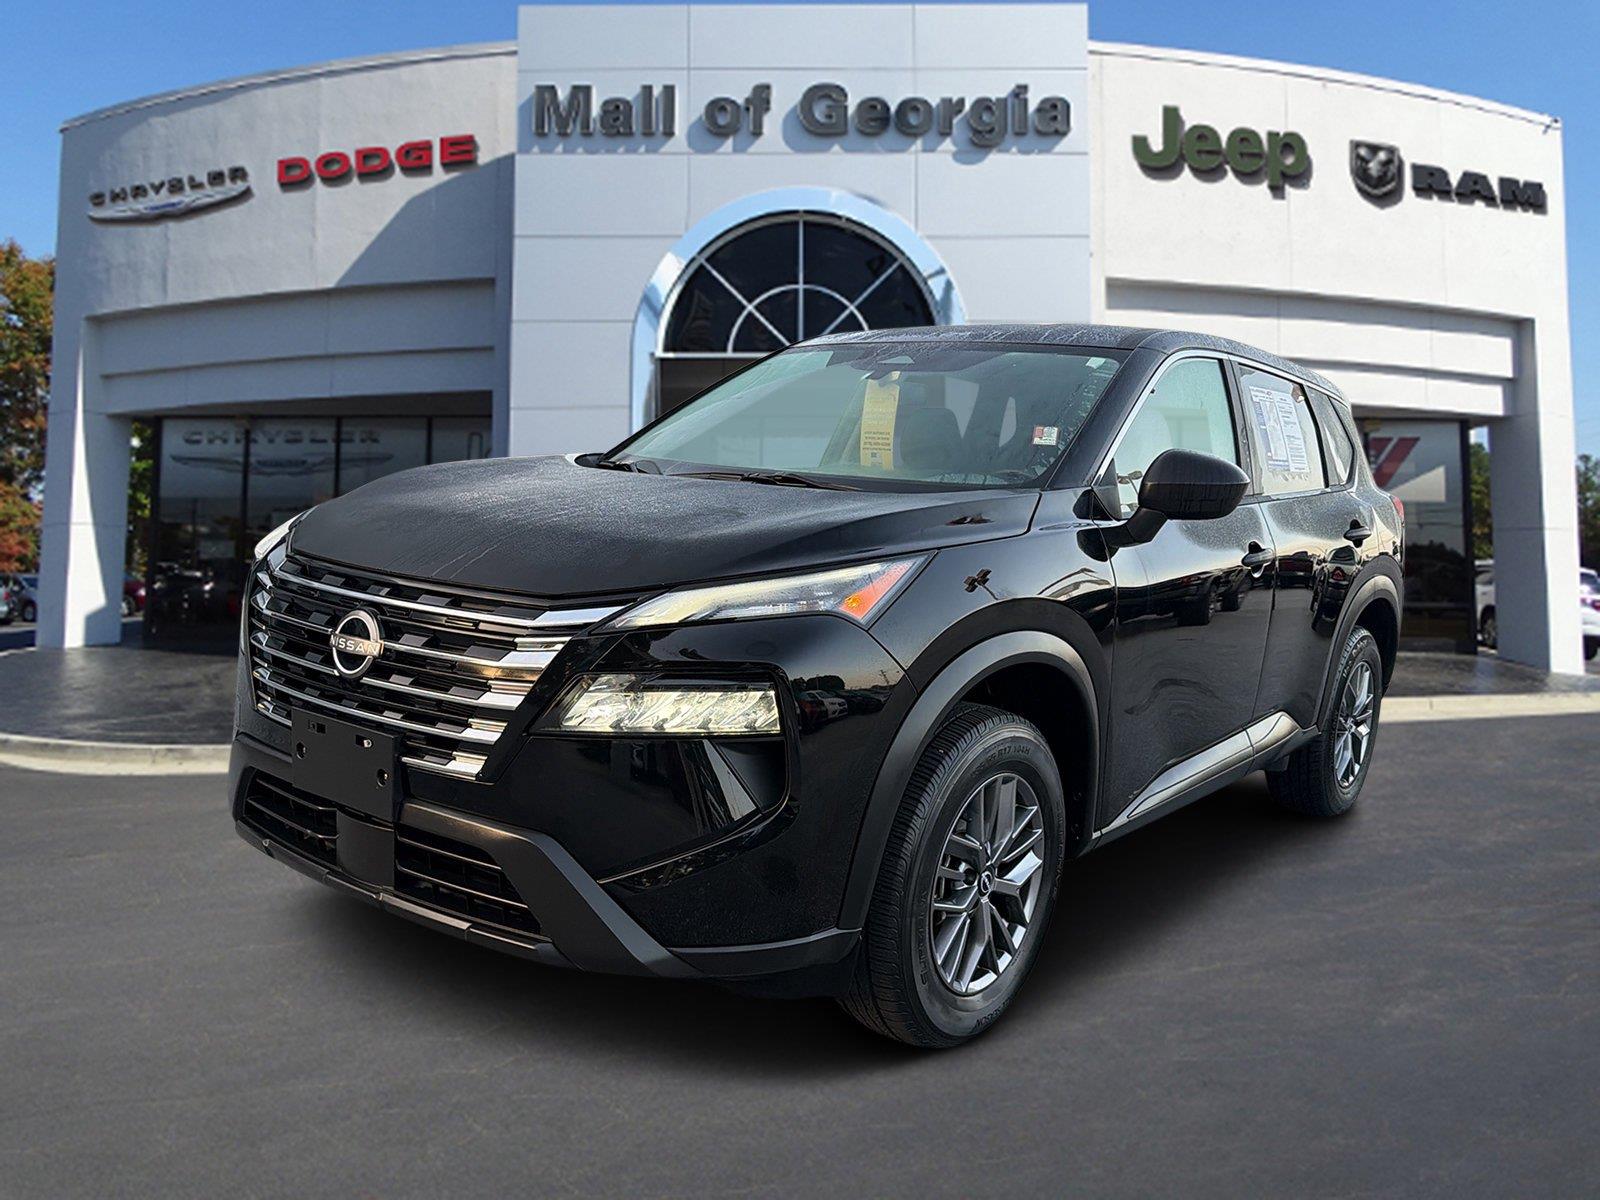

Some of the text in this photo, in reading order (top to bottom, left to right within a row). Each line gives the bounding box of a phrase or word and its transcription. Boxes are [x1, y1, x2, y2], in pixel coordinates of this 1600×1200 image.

[532, 82, 1072, 148] Mall of Georgia
[277, 134, 476, 187] DODGE
[1131, 104, 1309, 187] Jeep
[89, 166, 248, 207] CHRYSLER
[1410, 162, 1545, 211] RAM
[330, 634, 380, 656] NISSAN
